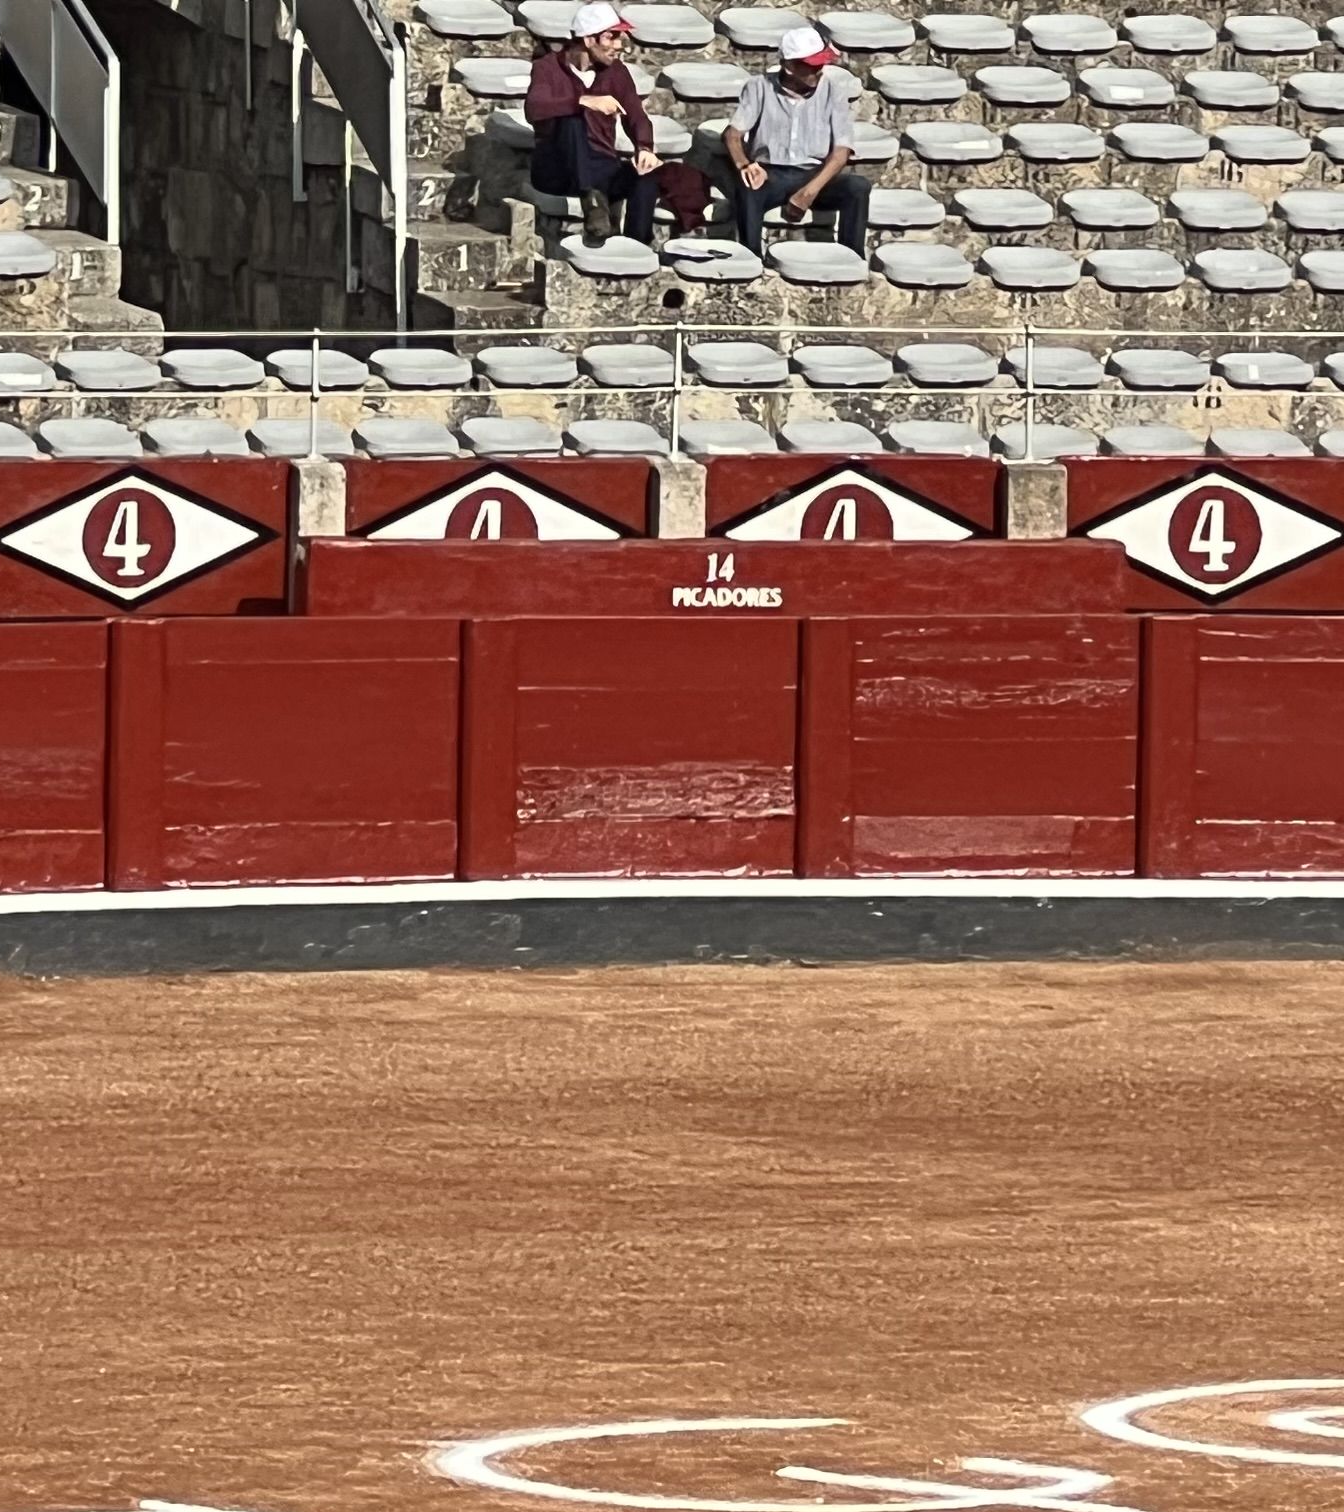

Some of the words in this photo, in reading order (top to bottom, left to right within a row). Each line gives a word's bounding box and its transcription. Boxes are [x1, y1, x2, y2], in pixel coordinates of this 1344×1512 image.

[418, 179, 437, 206] 2
[457, 244, 469, 272] 1
[103, 501, 151, 576] 4
[1189, 500, 1236, 571] 4
[706, 552, 735, 582] 14
[672, 587, 783, 607] PICADORES
